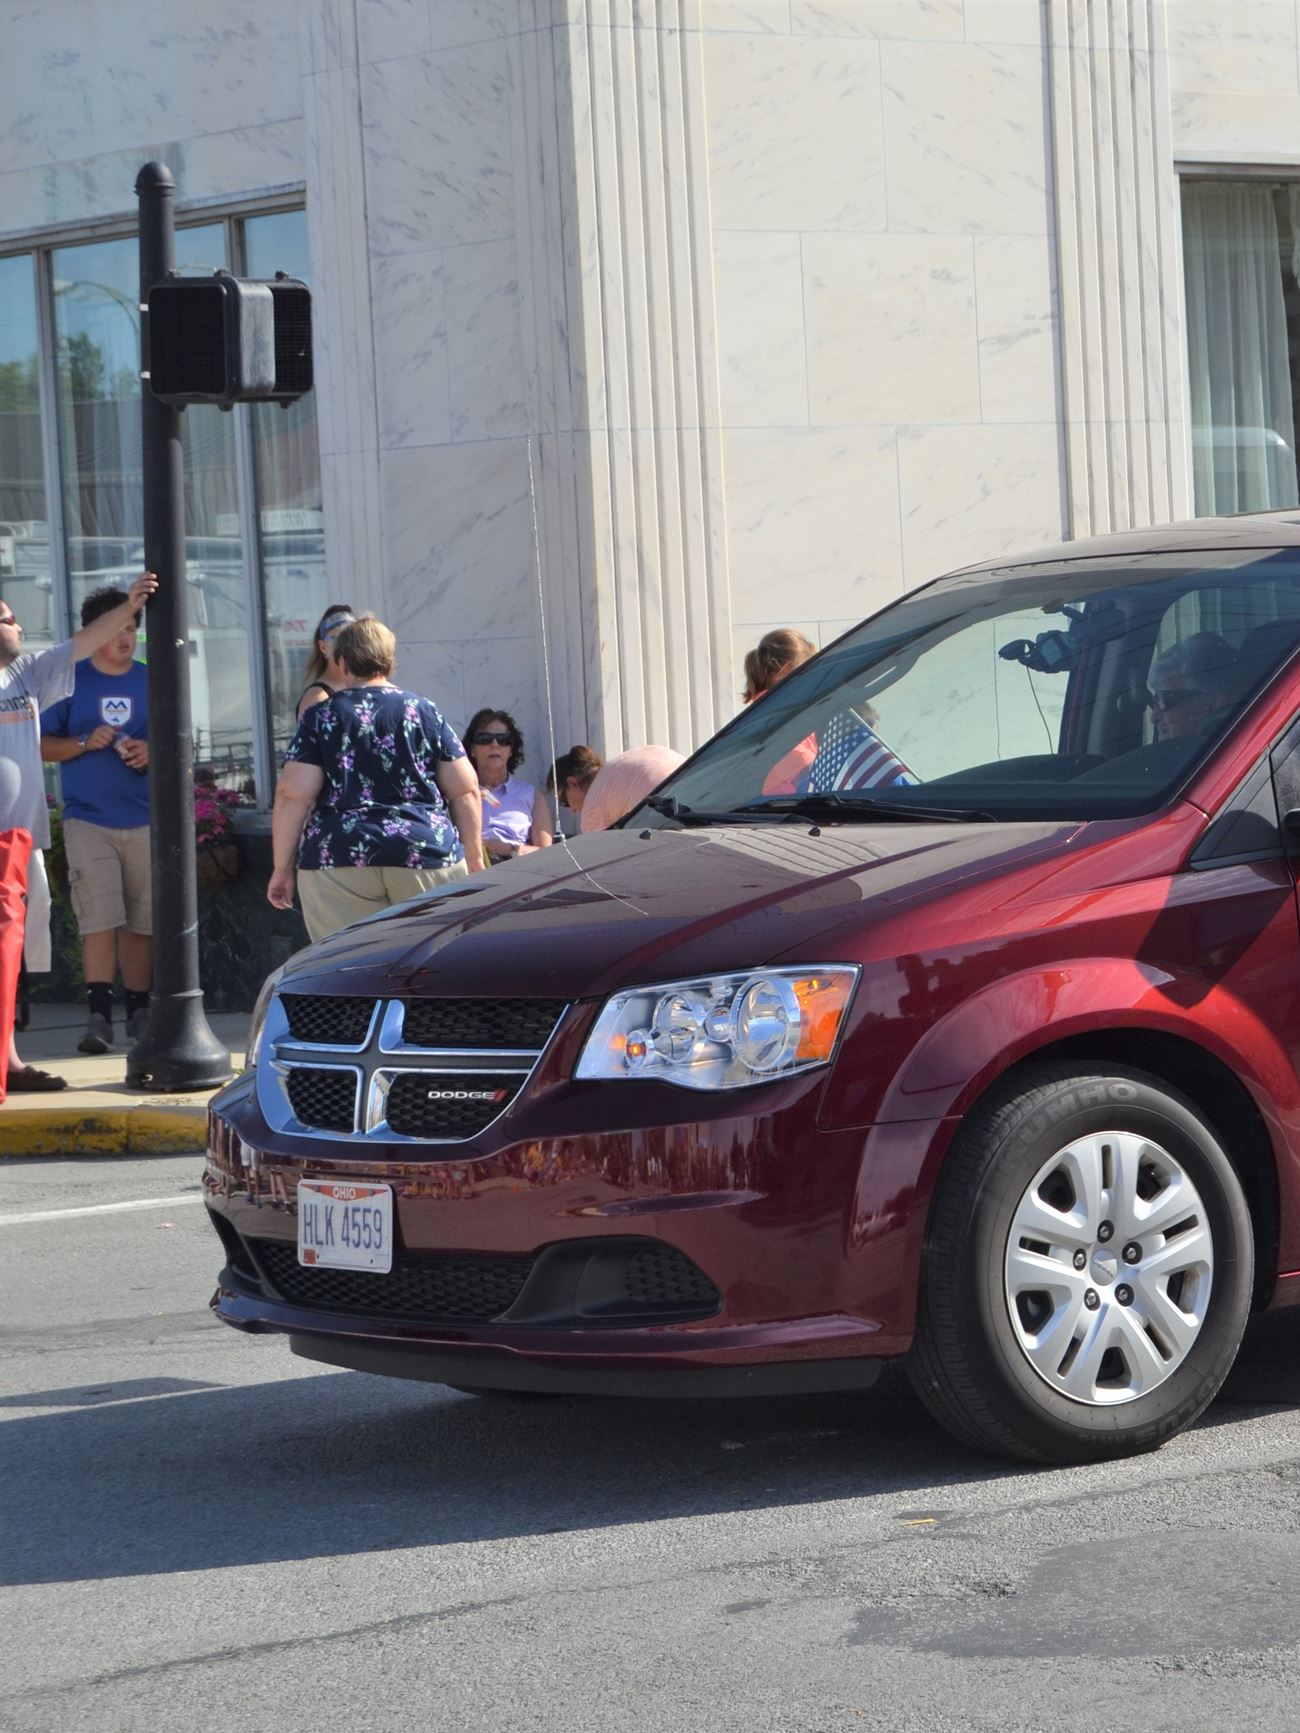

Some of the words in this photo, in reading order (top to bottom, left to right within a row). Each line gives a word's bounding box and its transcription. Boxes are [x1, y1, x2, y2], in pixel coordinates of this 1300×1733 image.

[428, 1091, 495, 1100] DODGE
[333, 1187, 356, 1199] OHIO
[304, 1204, 335, 1246] HLK
[341, 1206, 383, 1249] 4559
